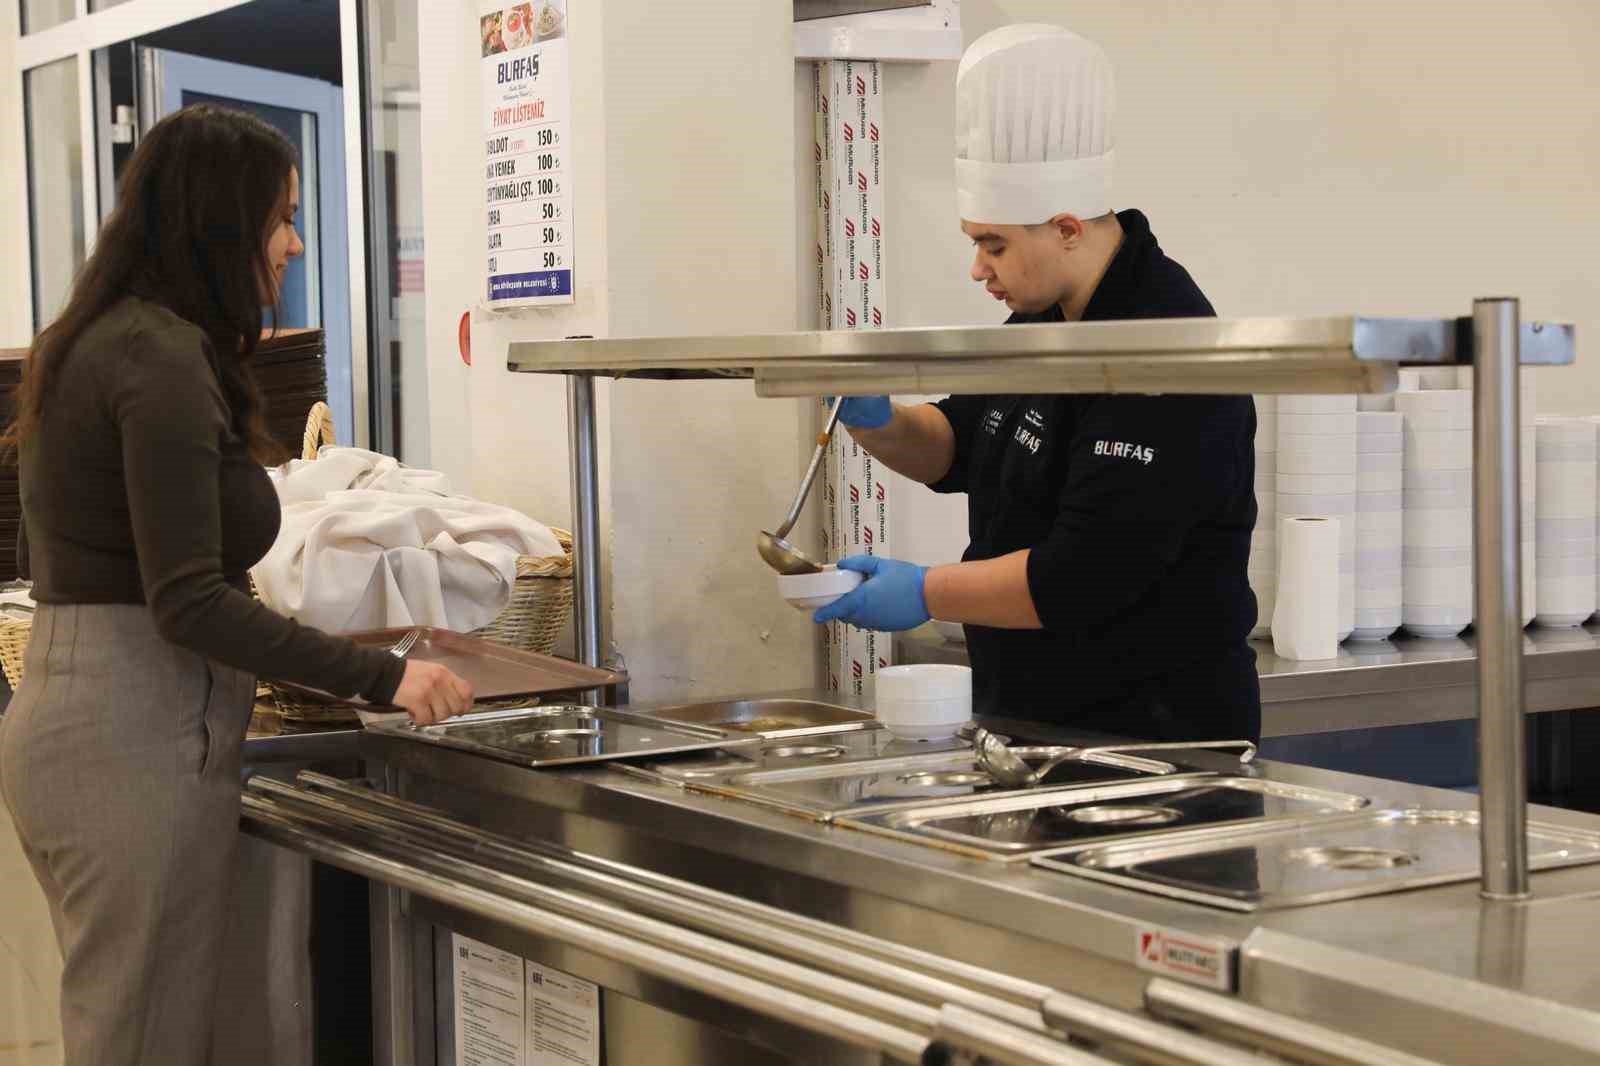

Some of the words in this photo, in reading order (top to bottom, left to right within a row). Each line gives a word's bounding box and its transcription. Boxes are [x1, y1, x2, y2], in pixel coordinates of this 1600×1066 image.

[497, 54, 539, 84] BURFAŞ
[513, 98, 545, 124] LİSTEMİZ
[537, 129, 552, 146] 150
[495, 160, 515, 177] YEMEK
[537, 154, 553, 170] 100
[537, 178, 553, 195] 100
[542, 203, 553, 219] 50
[543, 227, 554, 243] 50
[543, 252, 555, 268] 50
[1094, 440, 1154, 465] BURFAŞ
